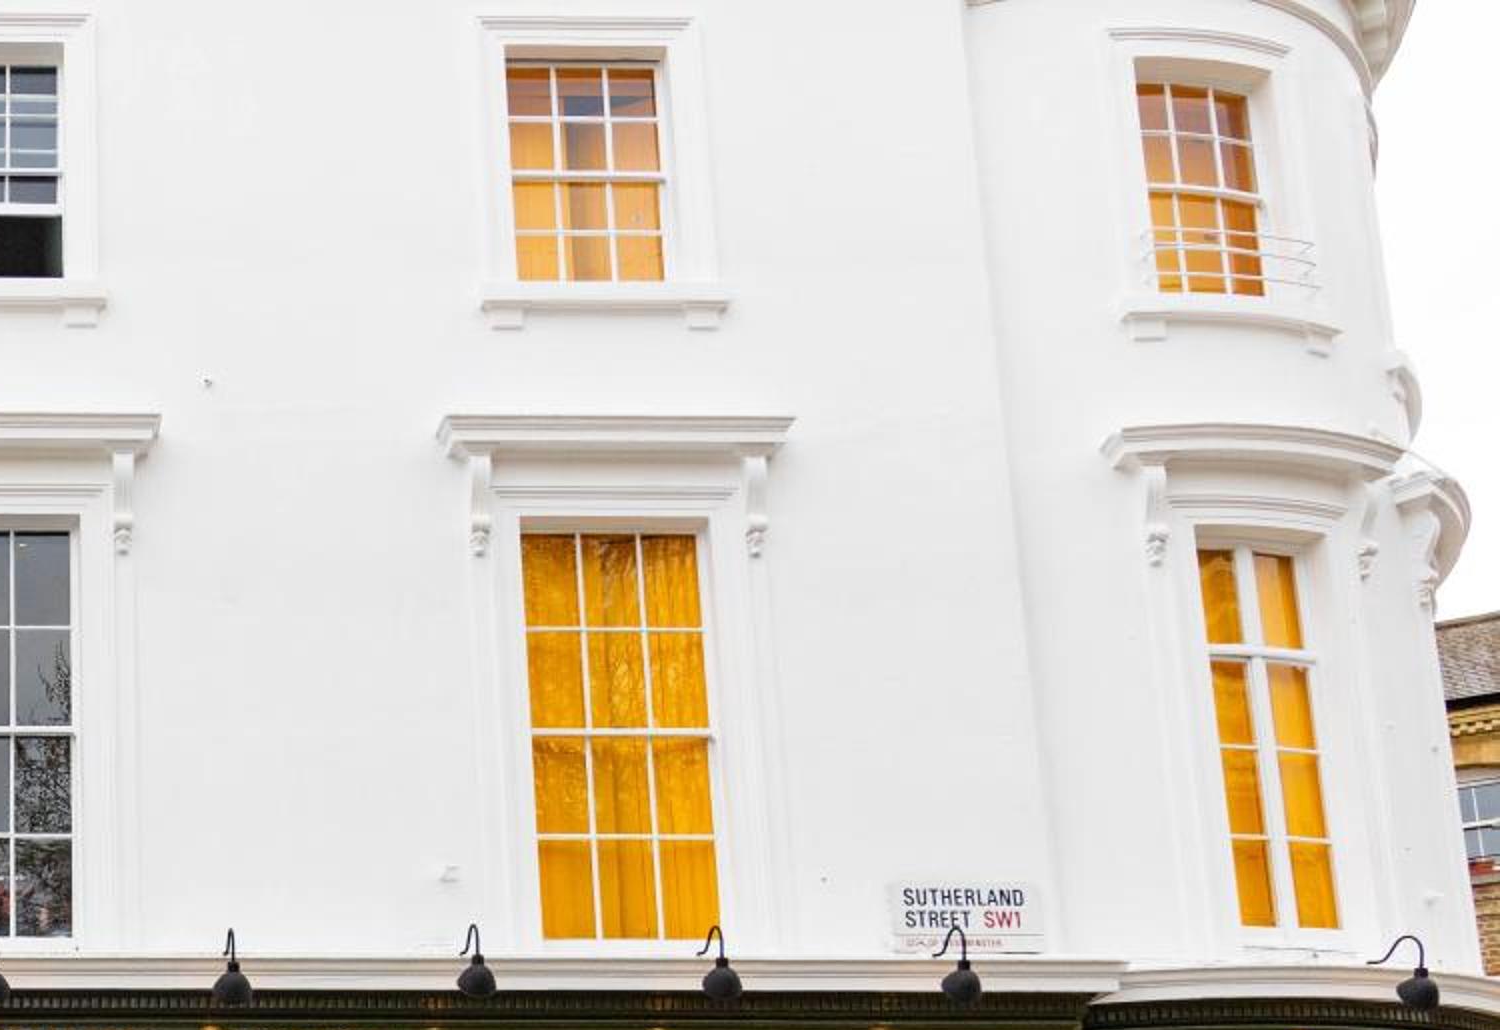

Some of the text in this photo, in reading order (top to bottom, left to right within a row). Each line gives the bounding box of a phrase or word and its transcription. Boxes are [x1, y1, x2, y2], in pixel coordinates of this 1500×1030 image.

[903, 888, 1024, 907] SUTHERLAND
[905, 911, 1021, 929] STREET SW1
